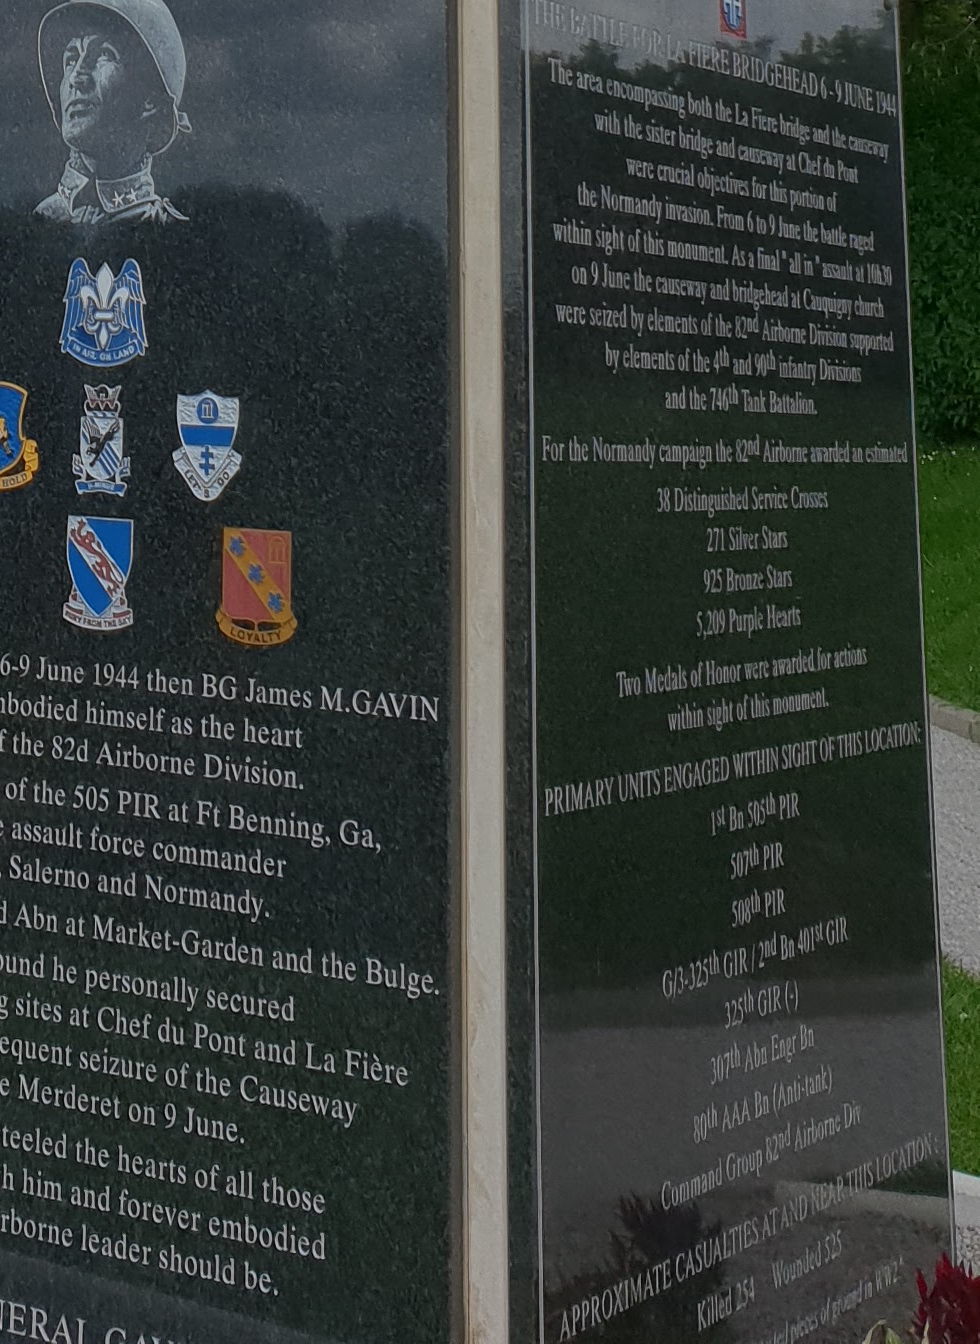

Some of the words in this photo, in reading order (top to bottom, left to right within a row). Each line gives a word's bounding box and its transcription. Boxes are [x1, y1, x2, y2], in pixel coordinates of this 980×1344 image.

[114, 345, 134, 359] LAND
[604, 340, 621, 375] by
[622, 342, 676, 371] elements
[677, 346, 691, 372] of
[692, 348, 711, 374] the
[712, 344, 730, 374] 4th
[732, 352, 753, 376] and
[753, 348, 777, 378] 90th
[778, 354, 817, 387] infantry
[818, 357, 862, 383] Divisions
[664, 384, 687, 410] and
[688, 385, 708, 411] the
[709, 382, 739, 412] 746th
[740, 388, 767, 413] Tank
[768, 389, 818, 415] Battalion.
[2, 473, 27, 487] HOLD
[656, 486, 672, 513] 38
[673, 486, 749, 519] Distinguished
[751, 485, 789, 511] Service
[790, 485, 829, 510] Crosses
[706, 526, 726, 553] 271
[728, 525, 760, 552] Silver
[761, 524, 789, 550] Stars
[702, 567, 723, 594] 925
[725, 566, 765, 593] Bronze
[765, 563, 793, 590] Stars
[230, 626, 281, 642] LOYALTY
[696, 608, 726, 641] 5,209
[728, 605, 764, 639] Purple
[765, 603, 802, 630] Hearts
[0, 652, 31, 678] 6-9
[35, 655, 86, 684] June
[92, 662, 140, 690] 1944
[146, 667, 194, 696] then
[201, 672, 238, 701] BG
[244, 677, 313, 709] James
[319, 685, 440, 722] M.GAVIN
[667, 702, 704, 732] within
[706, 697, 734, 732] sight
[735, 693, 750, 722] of
[750, 692, 771, 719] this
[772, 686, 830, 716] monument.
[12, 730, 45, 758] the
[51, 734, 89, 763] 82d
[95, 741, 196, 776] Airborne
[203, 752, 305, 791] Division.
[544, 775, 615, 817] PRIMARY
[616, 767, 662, 803] UNITS
[663, 755, 730, 794] ENGAGED
[732, 745, 779, 779] WITHIN
[781, 739, 817, 771] SIGHT
[819, 735, 836, 762] OF
[835, 730, 864, 759] THIS
[4, 776, 29, 802] of
[33, 779, 66, 807] the
[72, 784, 110, 813] 505
[117, 789, 162, 820] PIR
[168, 801, 189, 824] at
[195, 799, 221, 828] Ft
[228, 803, 332, 849] Benning,
[339, 818, 382, 854] Ga,
[728, 805, 745, 832] Bn
[778, 791, 801, 821] PIR
[762, 841, 785, 871] PIR
[8, 853, 90, 890] Salerno
[97, 871, 137, 898] and
[144, 873, 270, 924] Normandy.
[763, 887, 786, 918] PIR
[13, 902, 59, 934] Abn
[65, 915, 86, 938] at
[92, 913, 264, 967] Market-Garden
[271, 947, 314, 974] and
[321, 950, 357, 982] the
[365, 956, 440, 1000] Bulge.
[722, 947, 749, 979] GIR
[779, 934, 796, 961] Bn
[825, 915, 849, 946] GIR
[15, 991, 63, 1023] sites
[69, 1005, 90, 1029] at
[97, 1005, 153, 1040] Chef
[157, 1016, 186, 1046] du
[193, 1021, 247, 1058] Pont
[254, 1038, 297, 1066] and
[305, 1041, 336, 1074] La
[344, 1048, 409, 1087] Fière
[744, 1041, 768, 1073] Abn
[770, 1033, 797, 1064] Engr
[799, 1023, 815, 1051] Bn
[721, 1096, 752, 1133] AAA
[753, 1090, 770, 1119] Bn
[75, 1137, 110, 1168] the
[117, 1144, 187, 1185] hearts
[194, 1163, 221, 1192] of
[225, 1169, 254, 1200] all
[261, 1176, 326, 1215] those
[771, 1240, 822, 1290] Wounded
[696, 1285, 733, 1334] Killed
